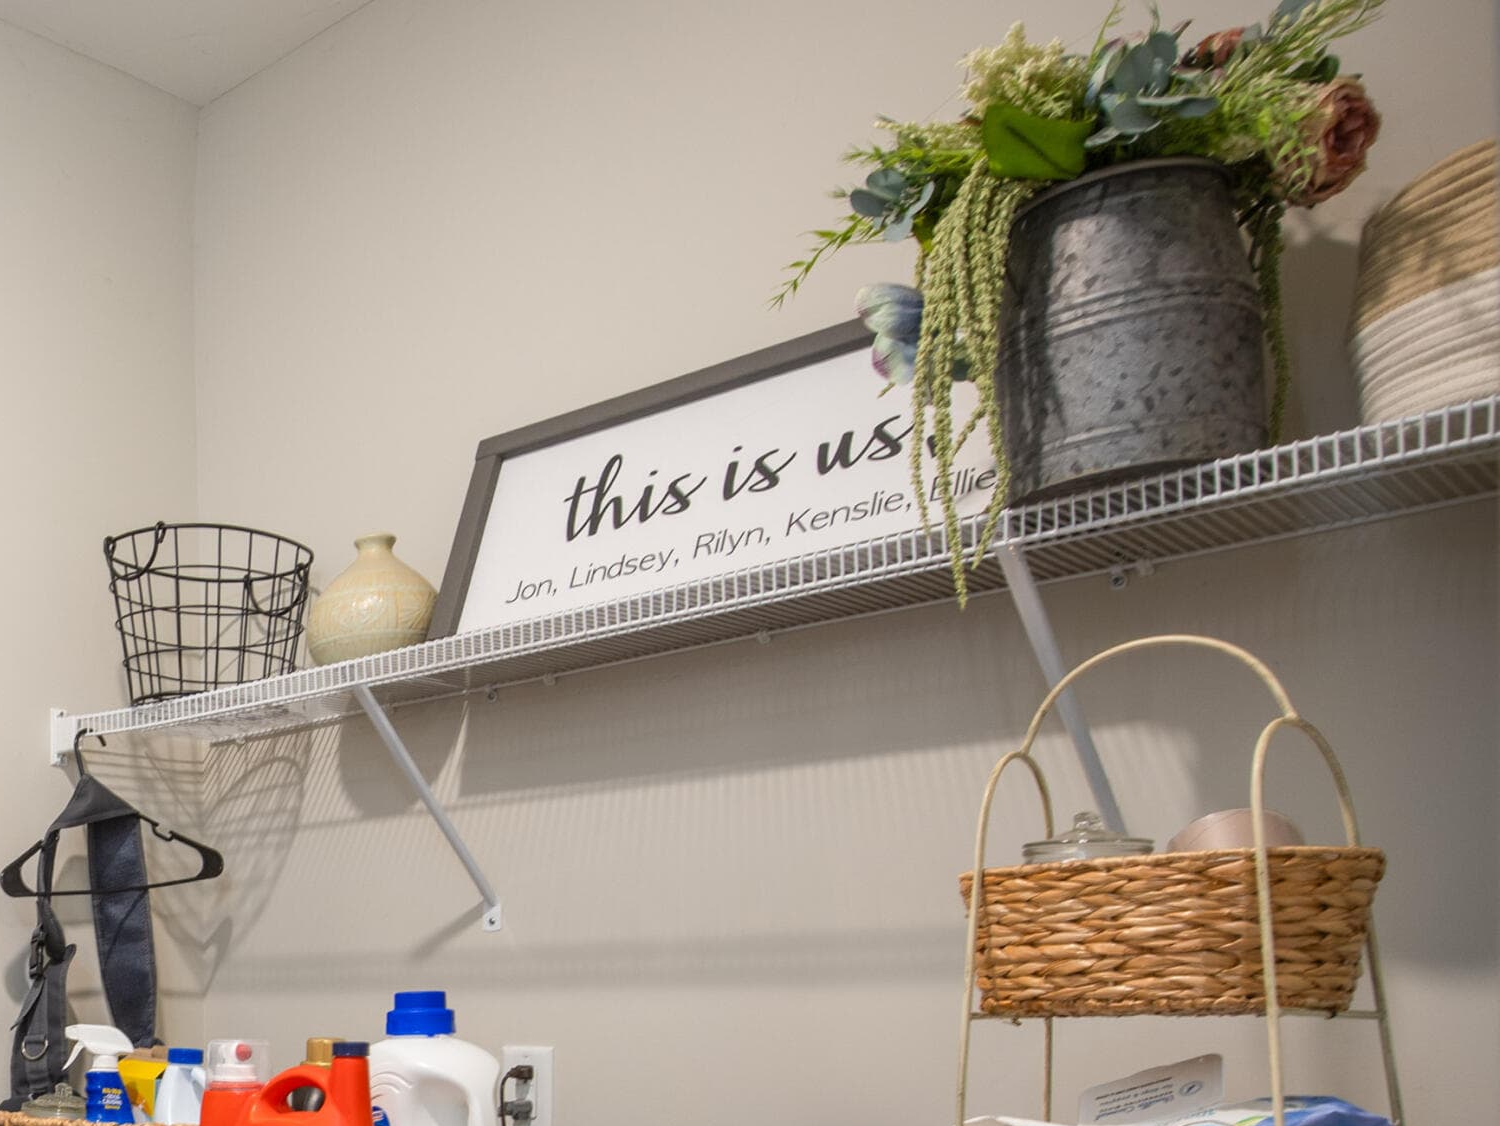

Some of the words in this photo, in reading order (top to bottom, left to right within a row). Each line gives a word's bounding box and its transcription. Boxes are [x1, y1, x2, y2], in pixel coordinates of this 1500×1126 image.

[564, 454, 707, 542] this
[723, 445, 797, 501] is
[505, 580, 558, 604] Jon,
[569, 548, 679, 589] Lindsey,
[693, 527, 770, 559] Rilyn,
[786, 491, 911, 537] Kenslie,
